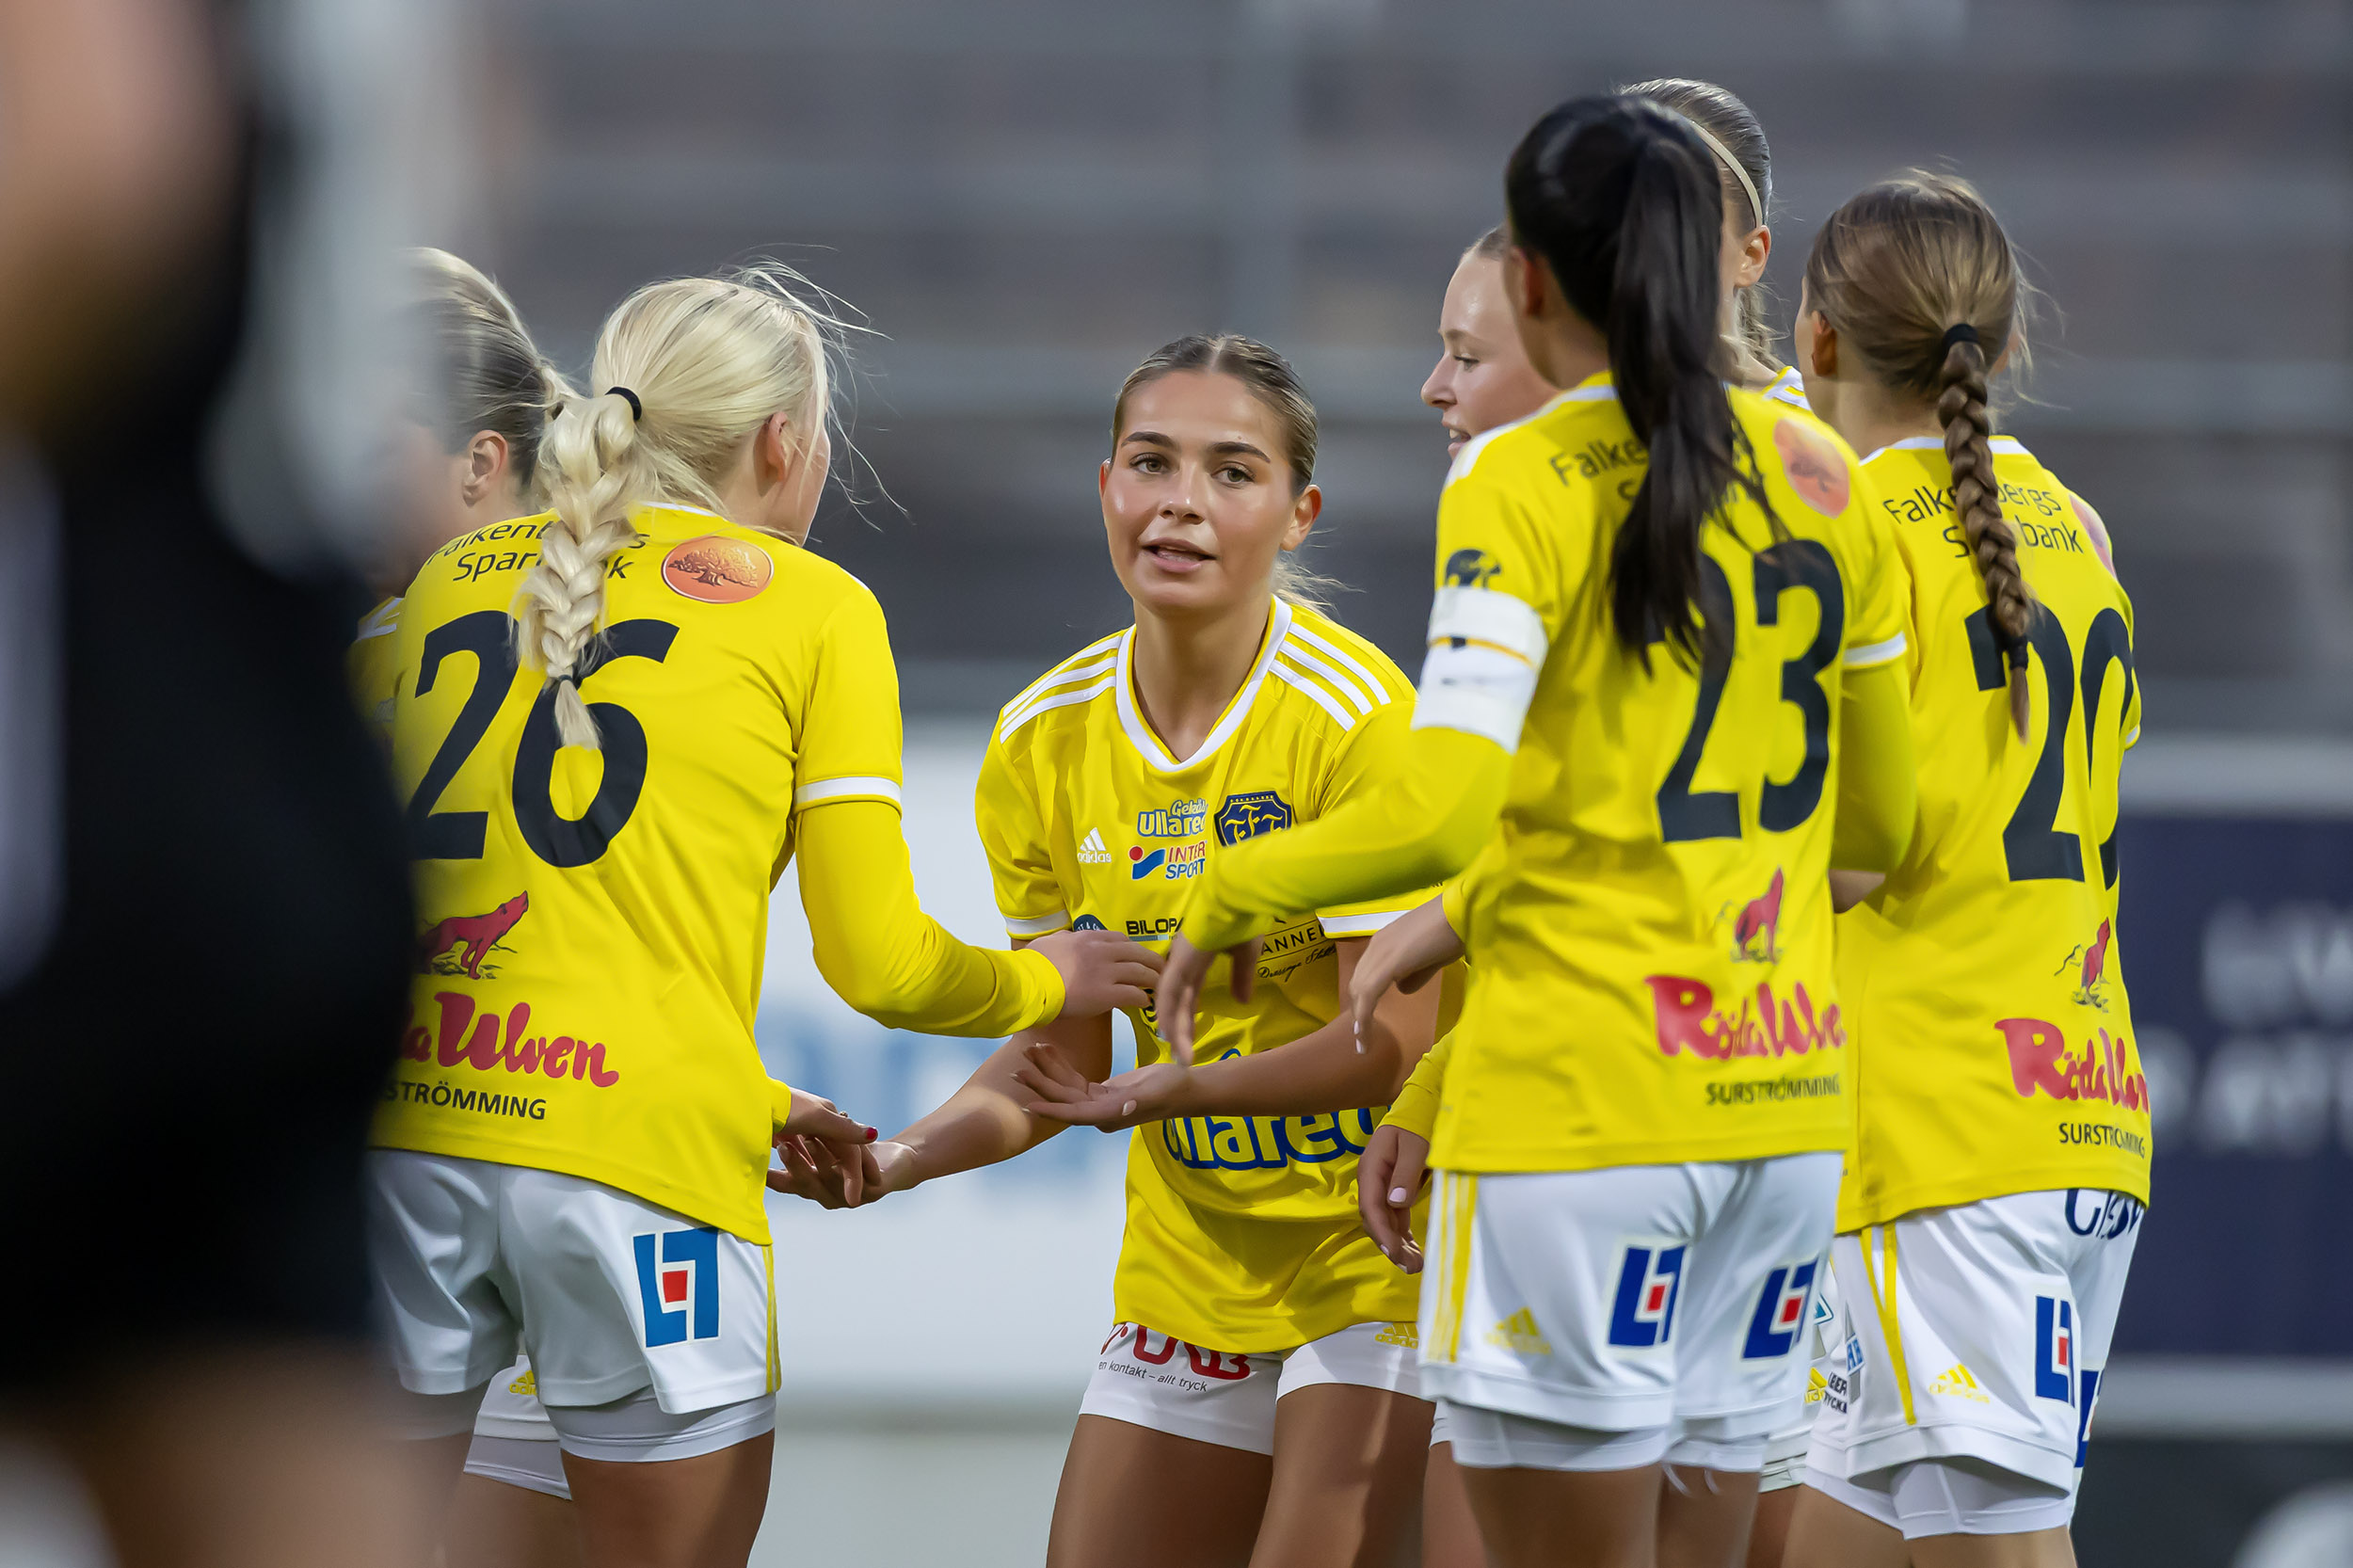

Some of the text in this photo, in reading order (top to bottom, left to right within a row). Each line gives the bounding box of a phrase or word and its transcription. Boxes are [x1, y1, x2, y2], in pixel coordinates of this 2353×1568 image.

[1882, 482, 2061, 525] Falkergs
[1943, 515, 2084, 558] Sbank
[453, 552, 633, 583] Spark
[1649, 537, 1845, 843] 23
[405, 610, 680, 869] 26
[1078, 850, 1112, 864] adidas
[1168, 840, 1206, 863] INTER
[1165, 857, 1206, 880] SPORT
[381, 1080, 547, 1120] STRÖMMING
[1375, 1333, 1418, 1350] adida
[1109, 1360, 1147, 1379] kontakt
[1158, 1374, 1176, 1385] allt
[1179, 1378, 1208, 1392] tryck
